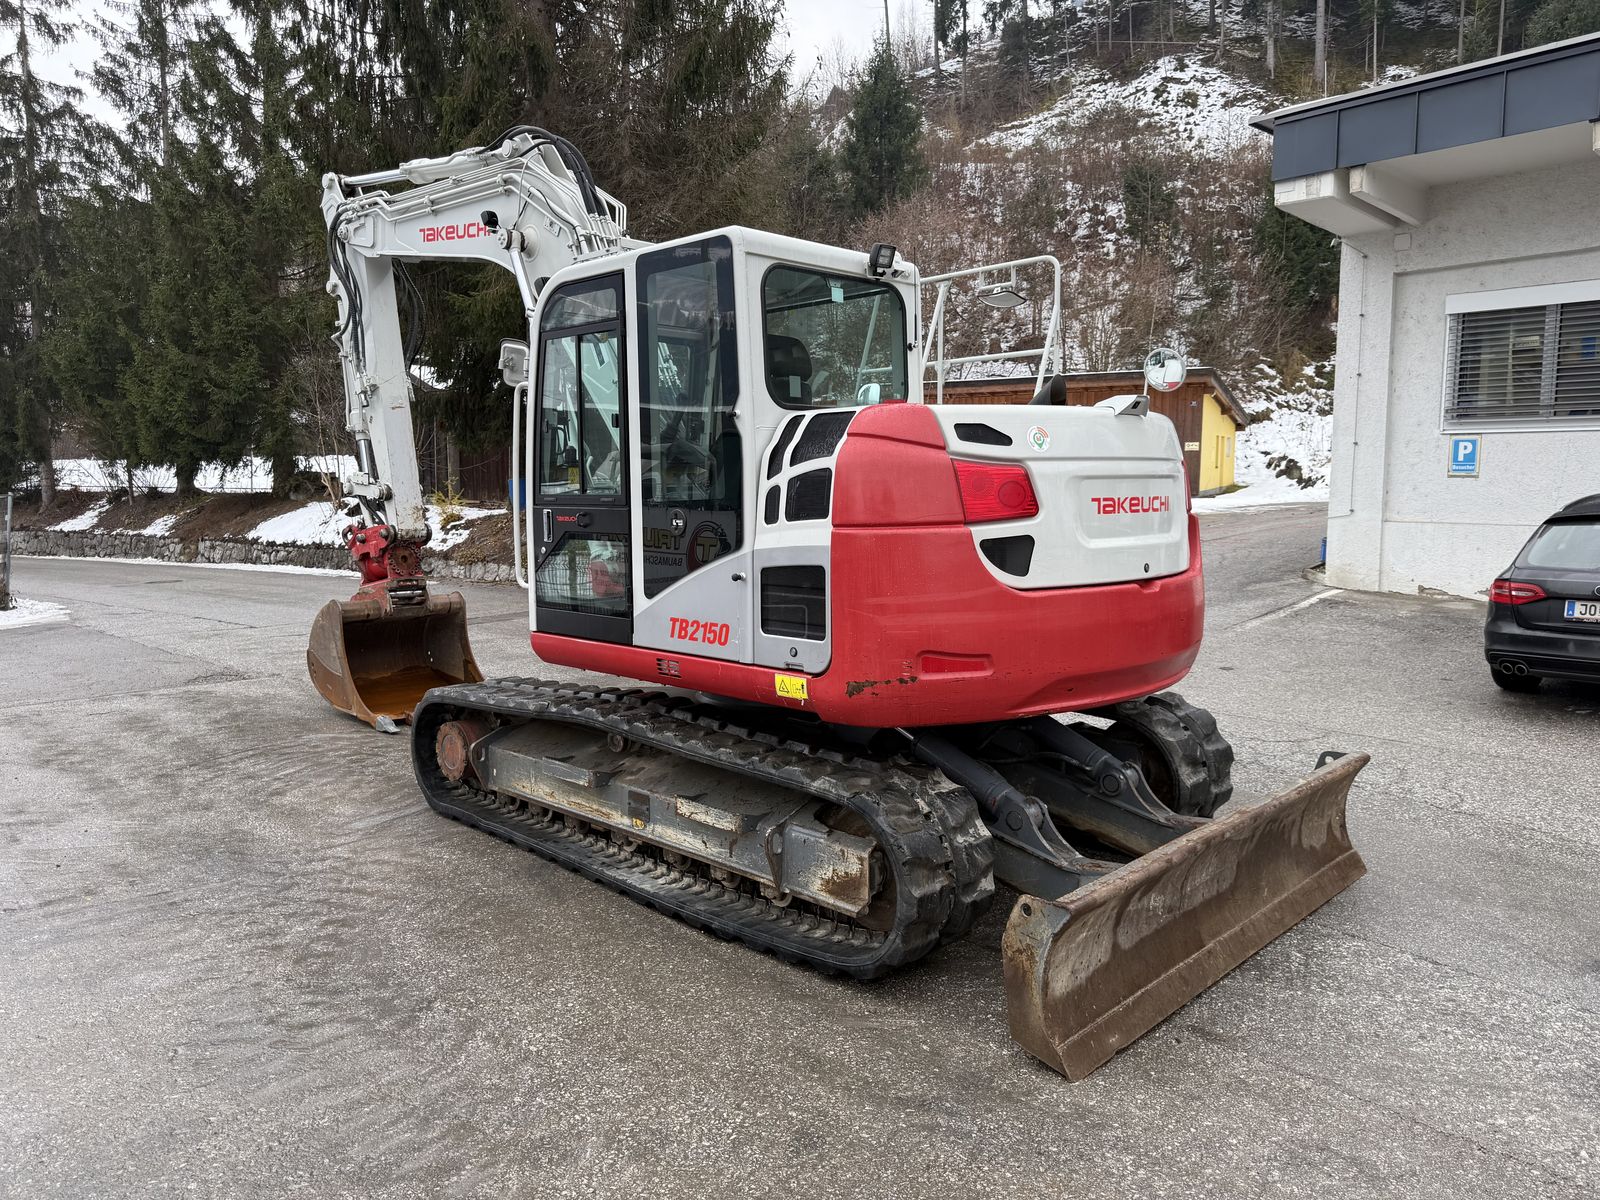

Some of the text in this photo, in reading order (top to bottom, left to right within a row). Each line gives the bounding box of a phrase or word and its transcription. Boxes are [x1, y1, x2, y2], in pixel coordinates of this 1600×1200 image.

[1457, 441, 1473, 462] P
[1091, 495, 1169, 514] TAKEUCHI
[1579, 603, 1597, 616] JO
[669, 616, 730, 647] TB2150
